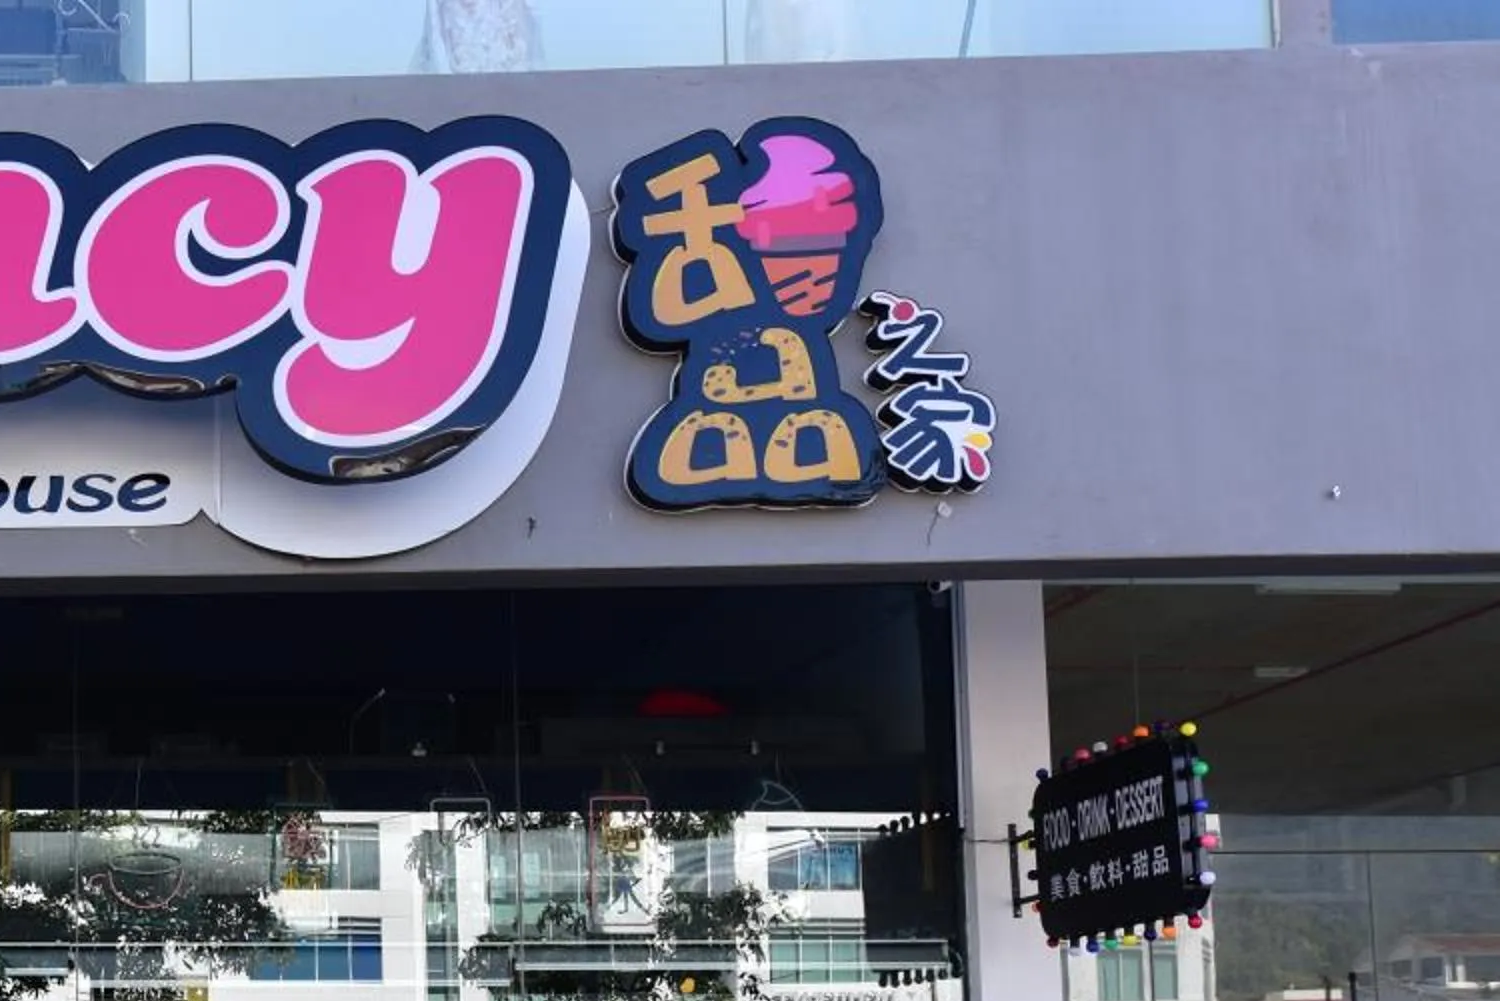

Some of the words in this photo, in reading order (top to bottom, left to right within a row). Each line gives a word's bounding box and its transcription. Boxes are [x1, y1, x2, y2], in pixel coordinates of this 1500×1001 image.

[1043, 806, 1070, 851] FOOD
[1077, 793, 1111, 841] DRINK
[1116, 775, 1165, 829] DESSERT
